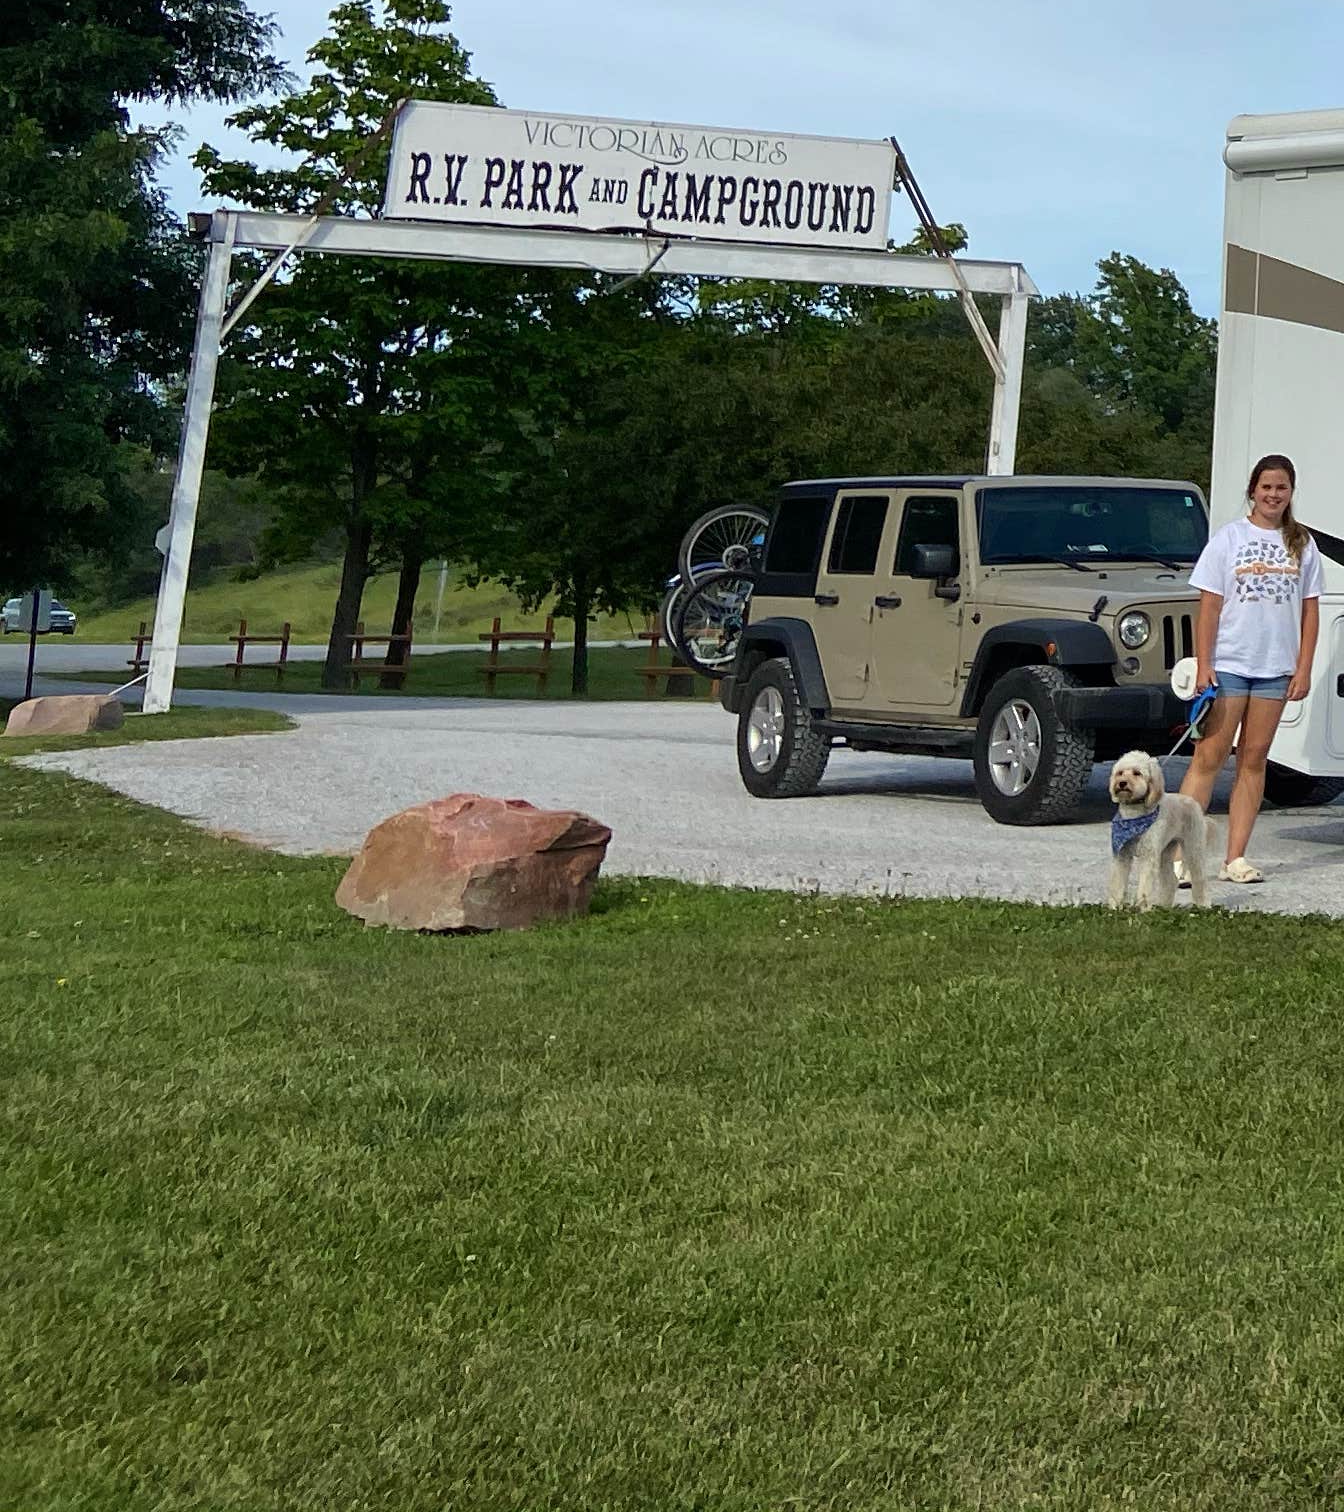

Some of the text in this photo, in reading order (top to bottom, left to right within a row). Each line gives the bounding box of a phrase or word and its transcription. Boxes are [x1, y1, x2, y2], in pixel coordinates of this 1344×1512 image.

[523, 119, 788, 165] VICTORIAN ACRES
[405, 152, 876, 234] R.V. PARK AND CAMPGROUND
